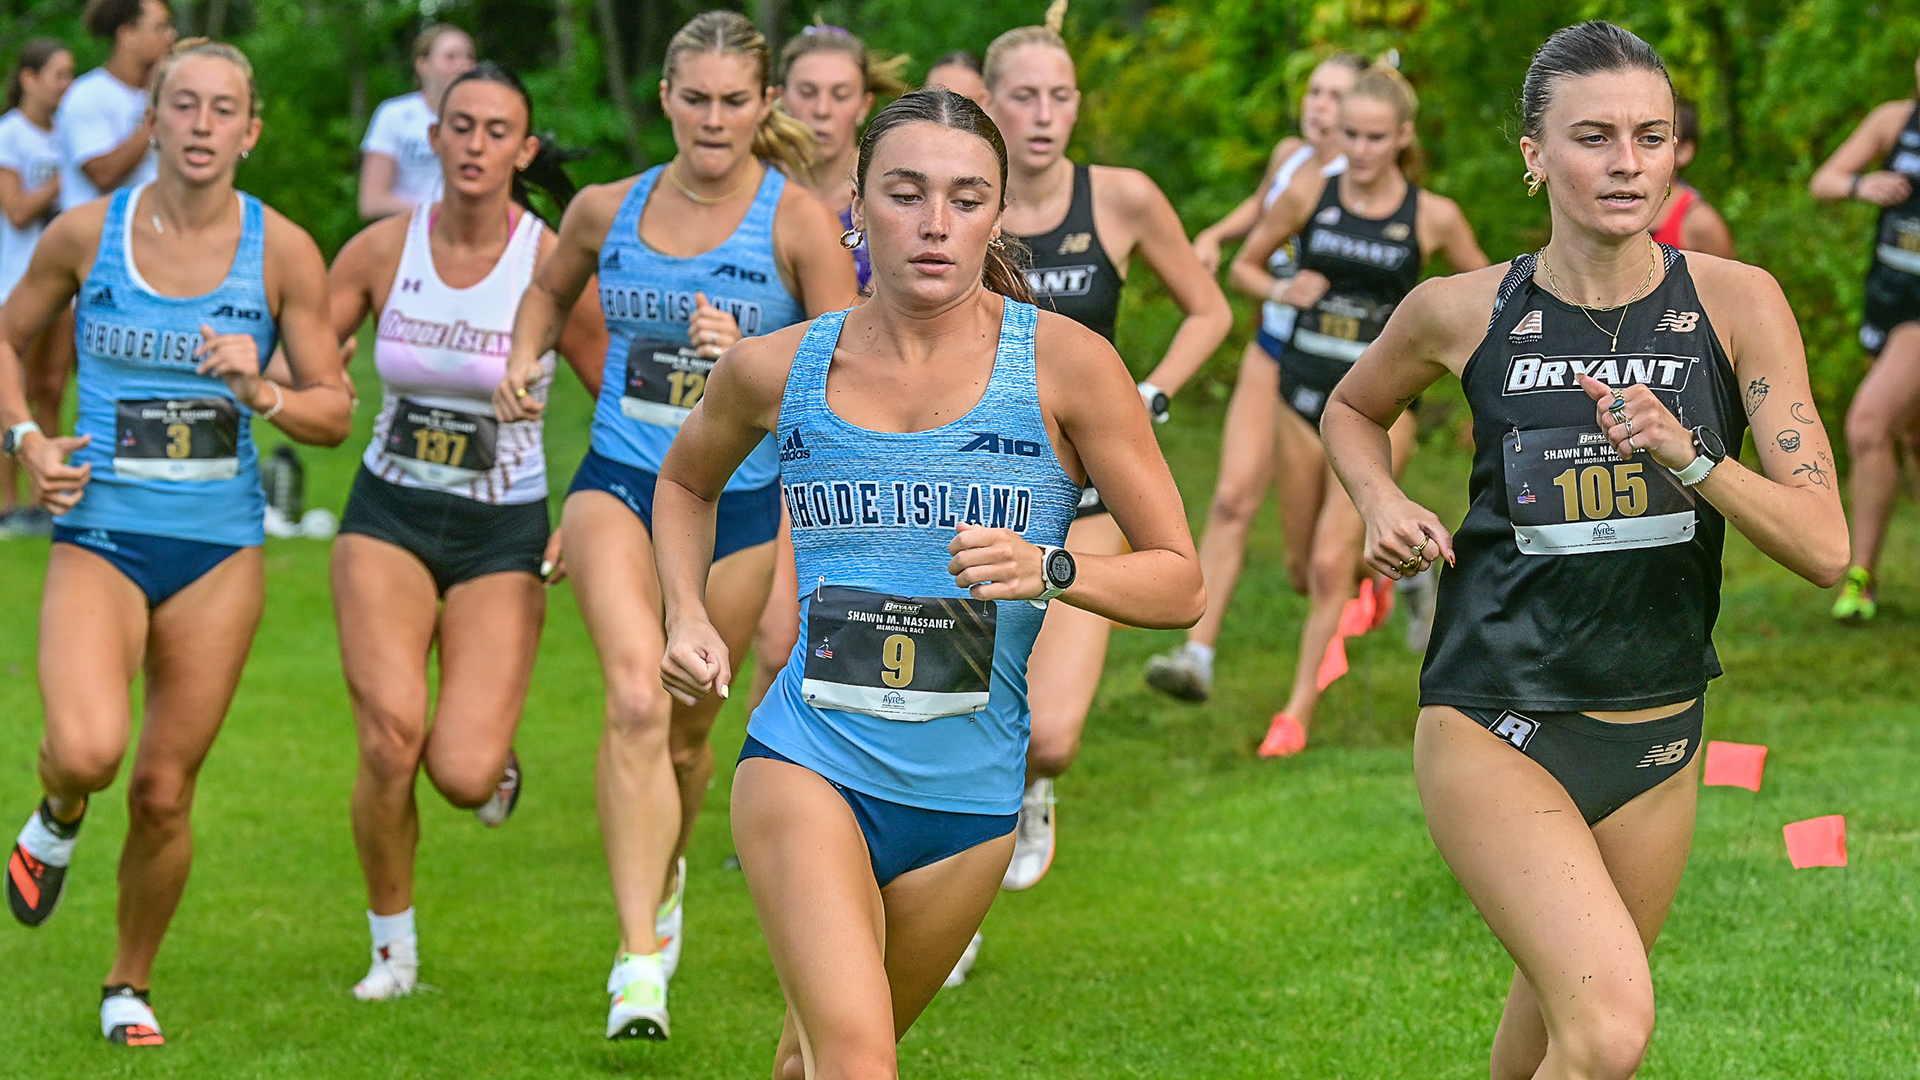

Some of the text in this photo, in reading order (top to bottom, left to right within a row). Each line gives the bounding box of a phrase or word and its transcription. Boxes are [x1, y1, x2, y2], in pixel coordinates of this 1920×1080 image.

[1027, 269, 1088, 292] ANT
[598, 286, 660, 321] HODE
[667, 371, 706, 409] 12
[1507, 357, 1684, 391] BRYANT
[166, 424, 191, 459] 3
[414, 429, 468, 468] 137
[957, 433, 1041, 457] A10
[1544, 448, 1580, 460] SHAWN
[1584, 447, 1597, 457] M.
[1574, 457, 1606, 465] MEMORIAL
[782, 481, 1032, 535] RHODE ISLAND
[1553, 463, 1648, 521] 105
[847, 610, 883, 624] SHAWN
[886, 615, 900, 625] M.
[903, 616, 956, 629] NASSANEY
[884, 602, 919, 612] BRYANT
[876, 624, 908, 633] MEMORIAL
[881, 634, 916, 689] 9
